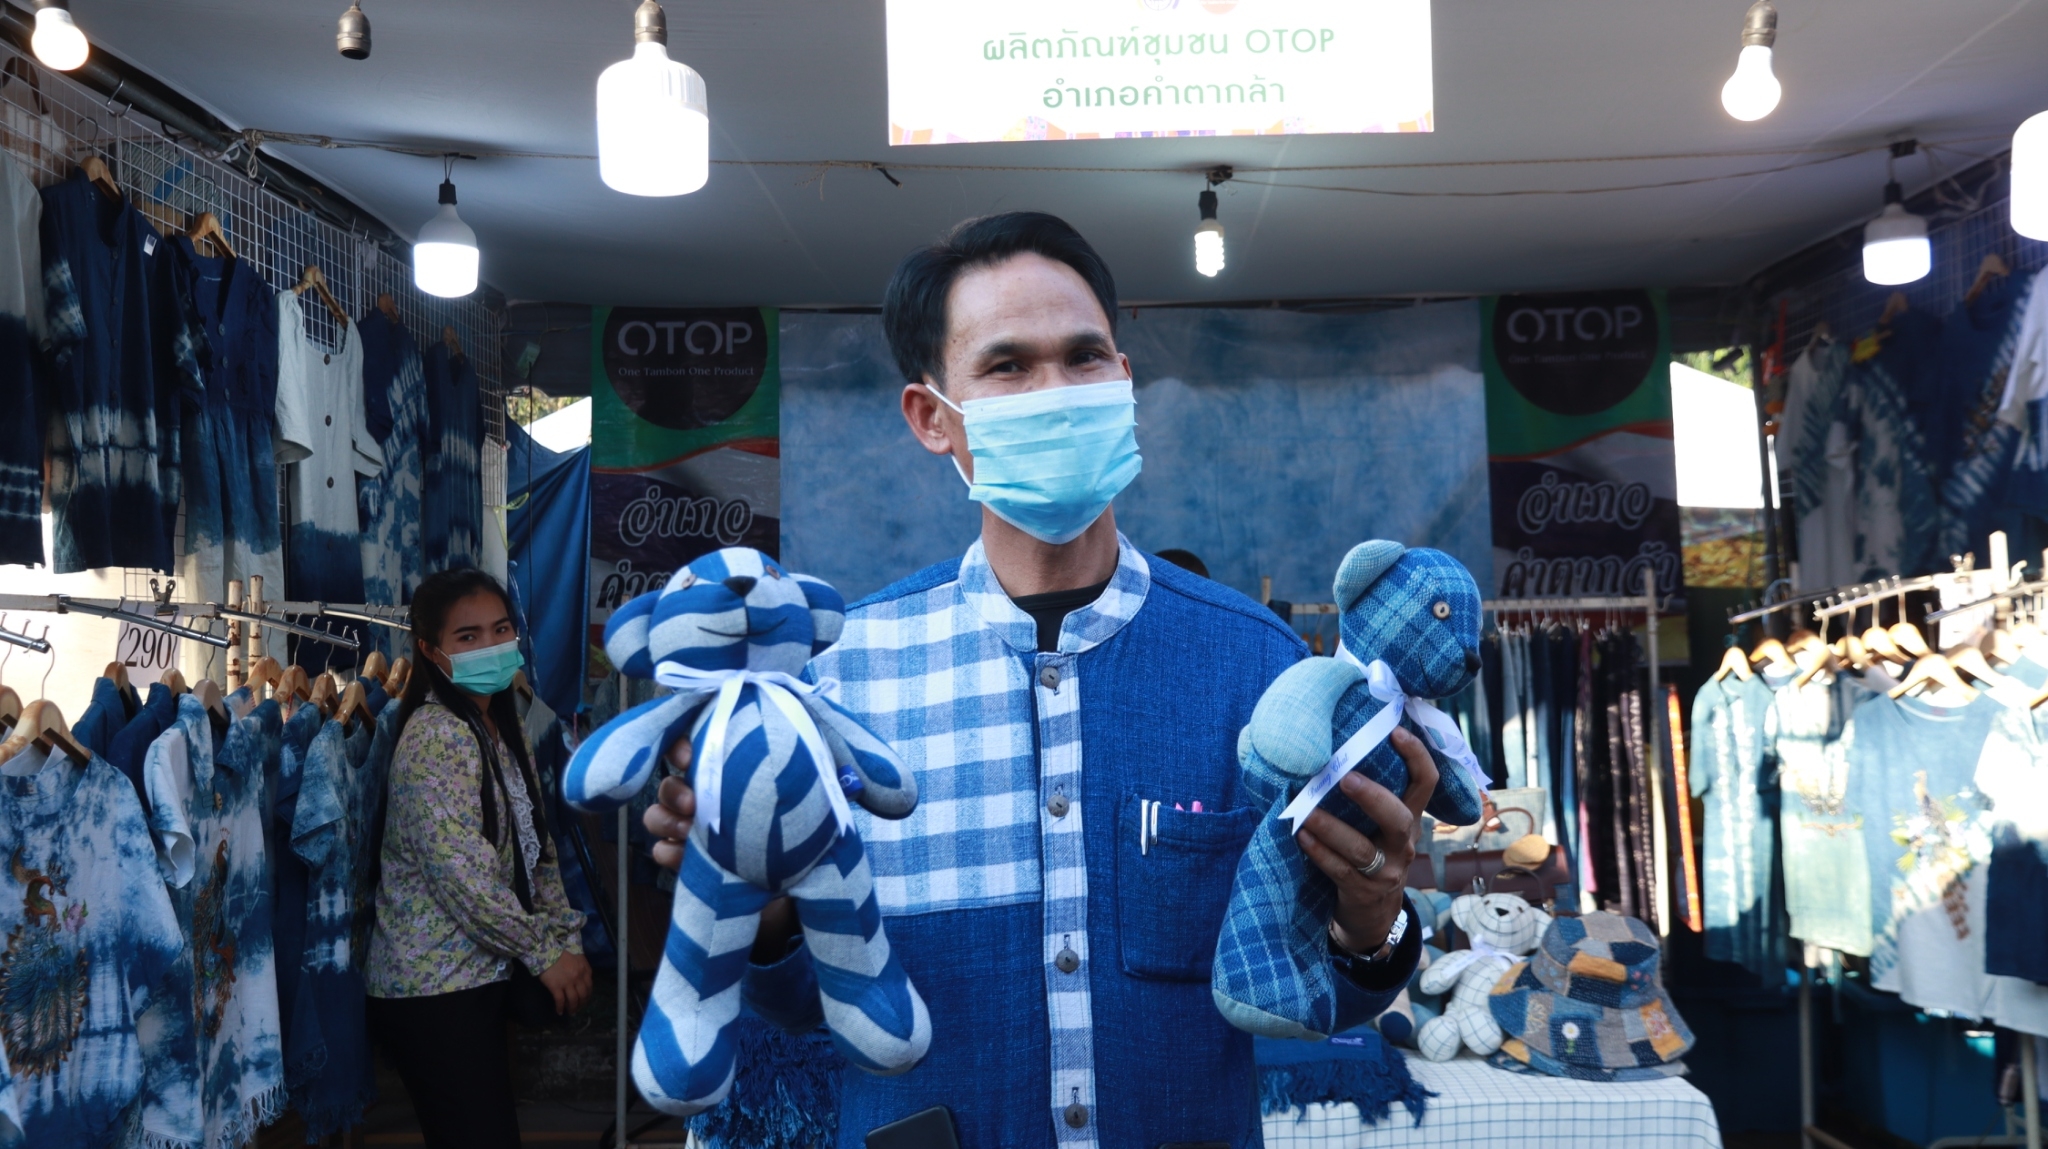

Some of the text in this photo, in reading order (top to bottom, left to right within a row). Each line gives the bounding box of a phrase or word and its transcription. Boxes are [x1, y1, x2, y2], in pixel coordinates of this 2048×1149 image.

[983, 26, 1336, 65] ผลิตภัณฑ์ชุมชน OTOP
[1042, 74, 1286, 109] อำเภอคำตากล้า
[617, 320, 753, 356] OTOP
[1506, 305, 1643, 343] OTOP
[618, 366, 755, 377] One Tambon One Product
[618, 485, 753, 547] อำเภอ
[1517, 470, 1653, 535] อำเภอ
[124, 627, 172, 670] 290
